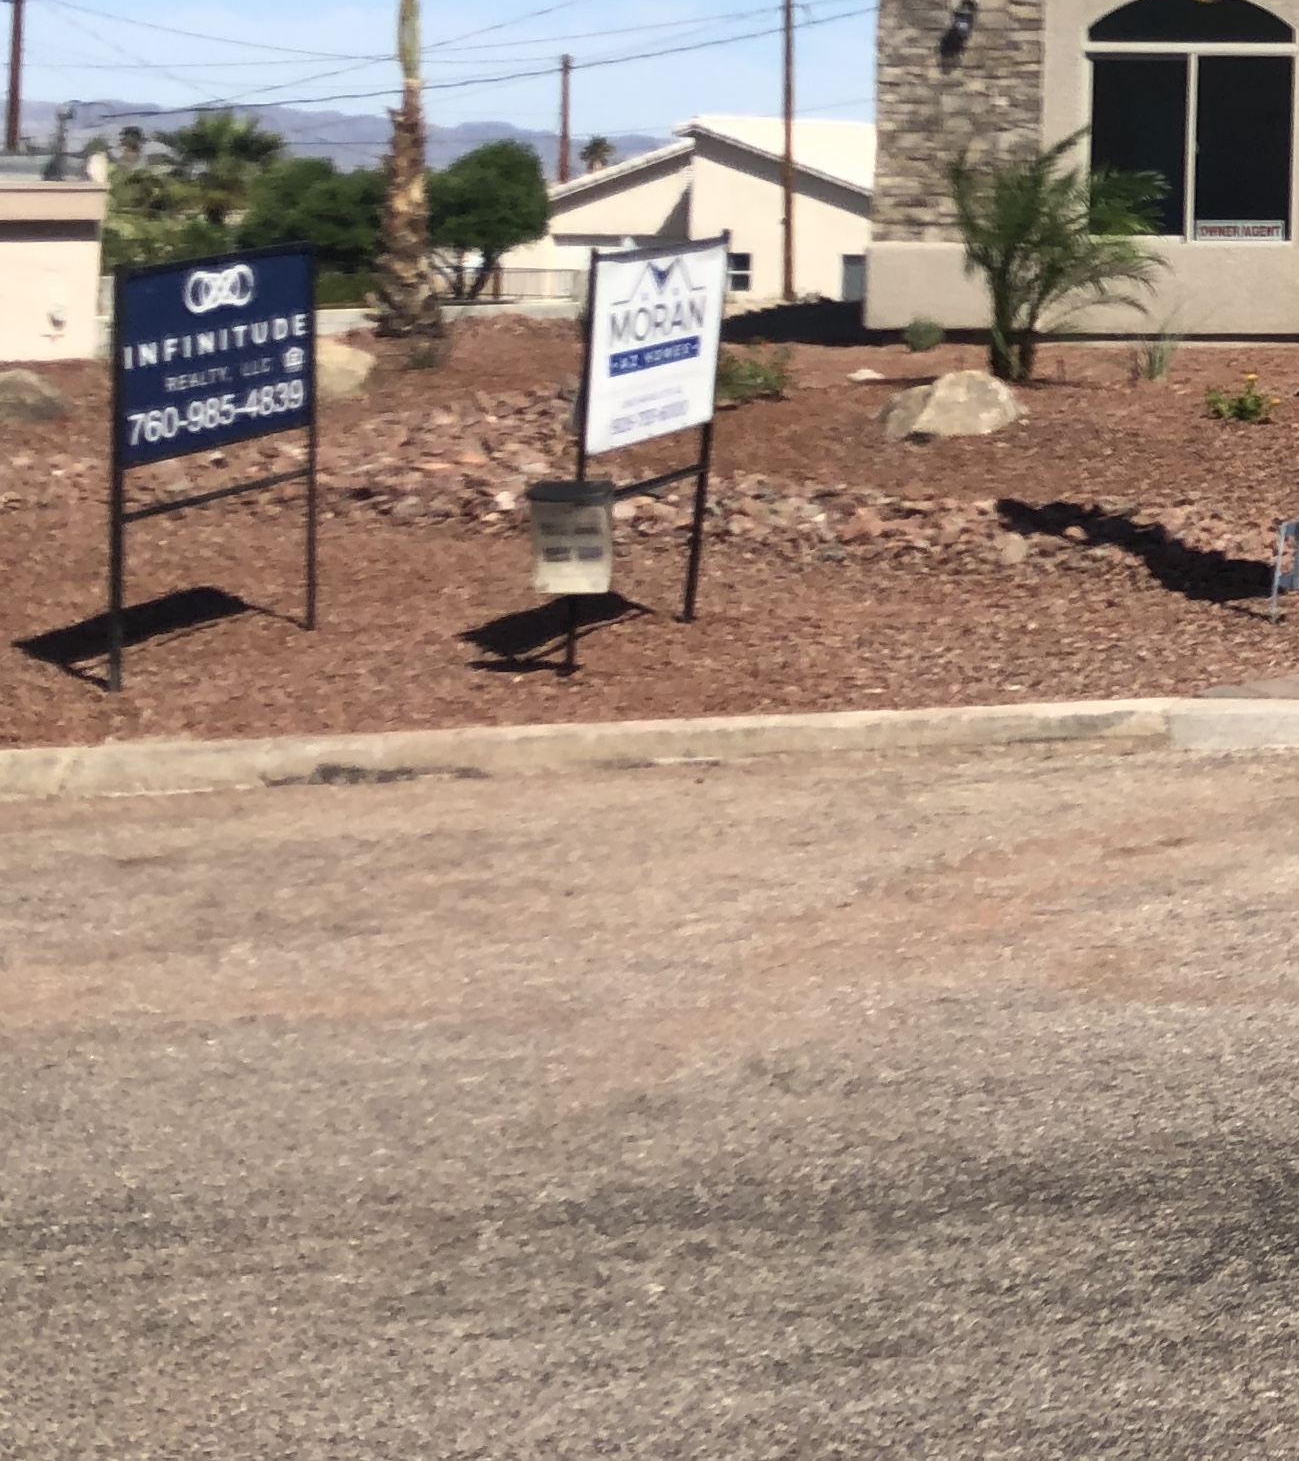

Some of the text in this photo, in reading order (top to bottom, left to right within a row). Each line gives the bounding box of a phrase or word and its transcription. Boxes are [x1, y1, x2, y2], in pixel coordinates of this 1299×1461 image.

[123, 313, 308, 370] INFINITUDE
[609, 295, 706, 348] MORAN
[127, 378, 305, 446] 760-985-4839
